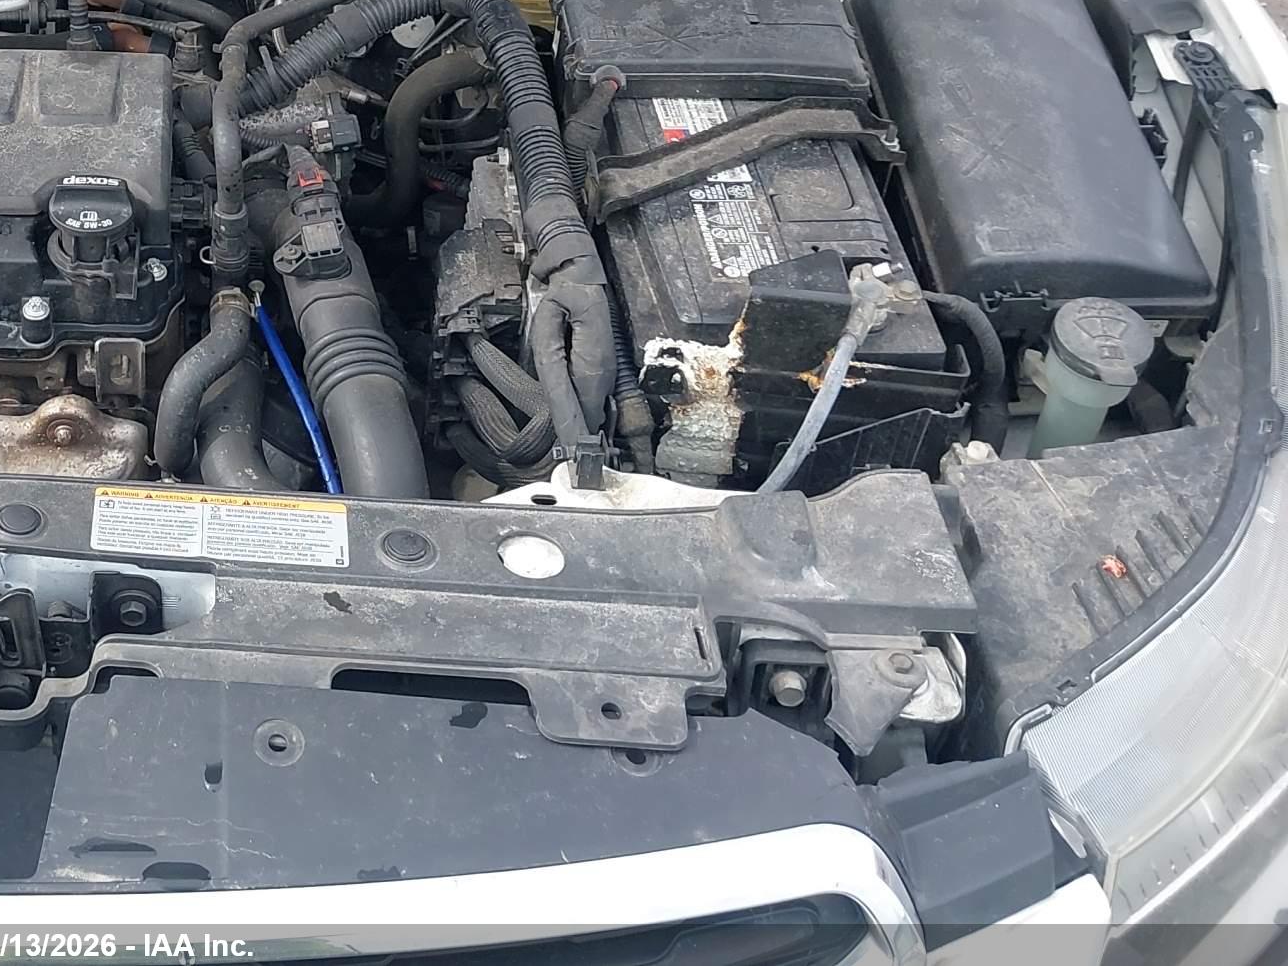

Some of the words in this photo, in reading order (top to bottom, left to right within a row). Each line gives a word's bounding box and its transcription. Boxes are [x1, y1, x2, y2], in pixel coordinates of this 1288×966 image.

[62, 175, 119, 186] dexos
[65, 217, 82, 228] SAE
[83, 218, 113, 229] 5W-30
